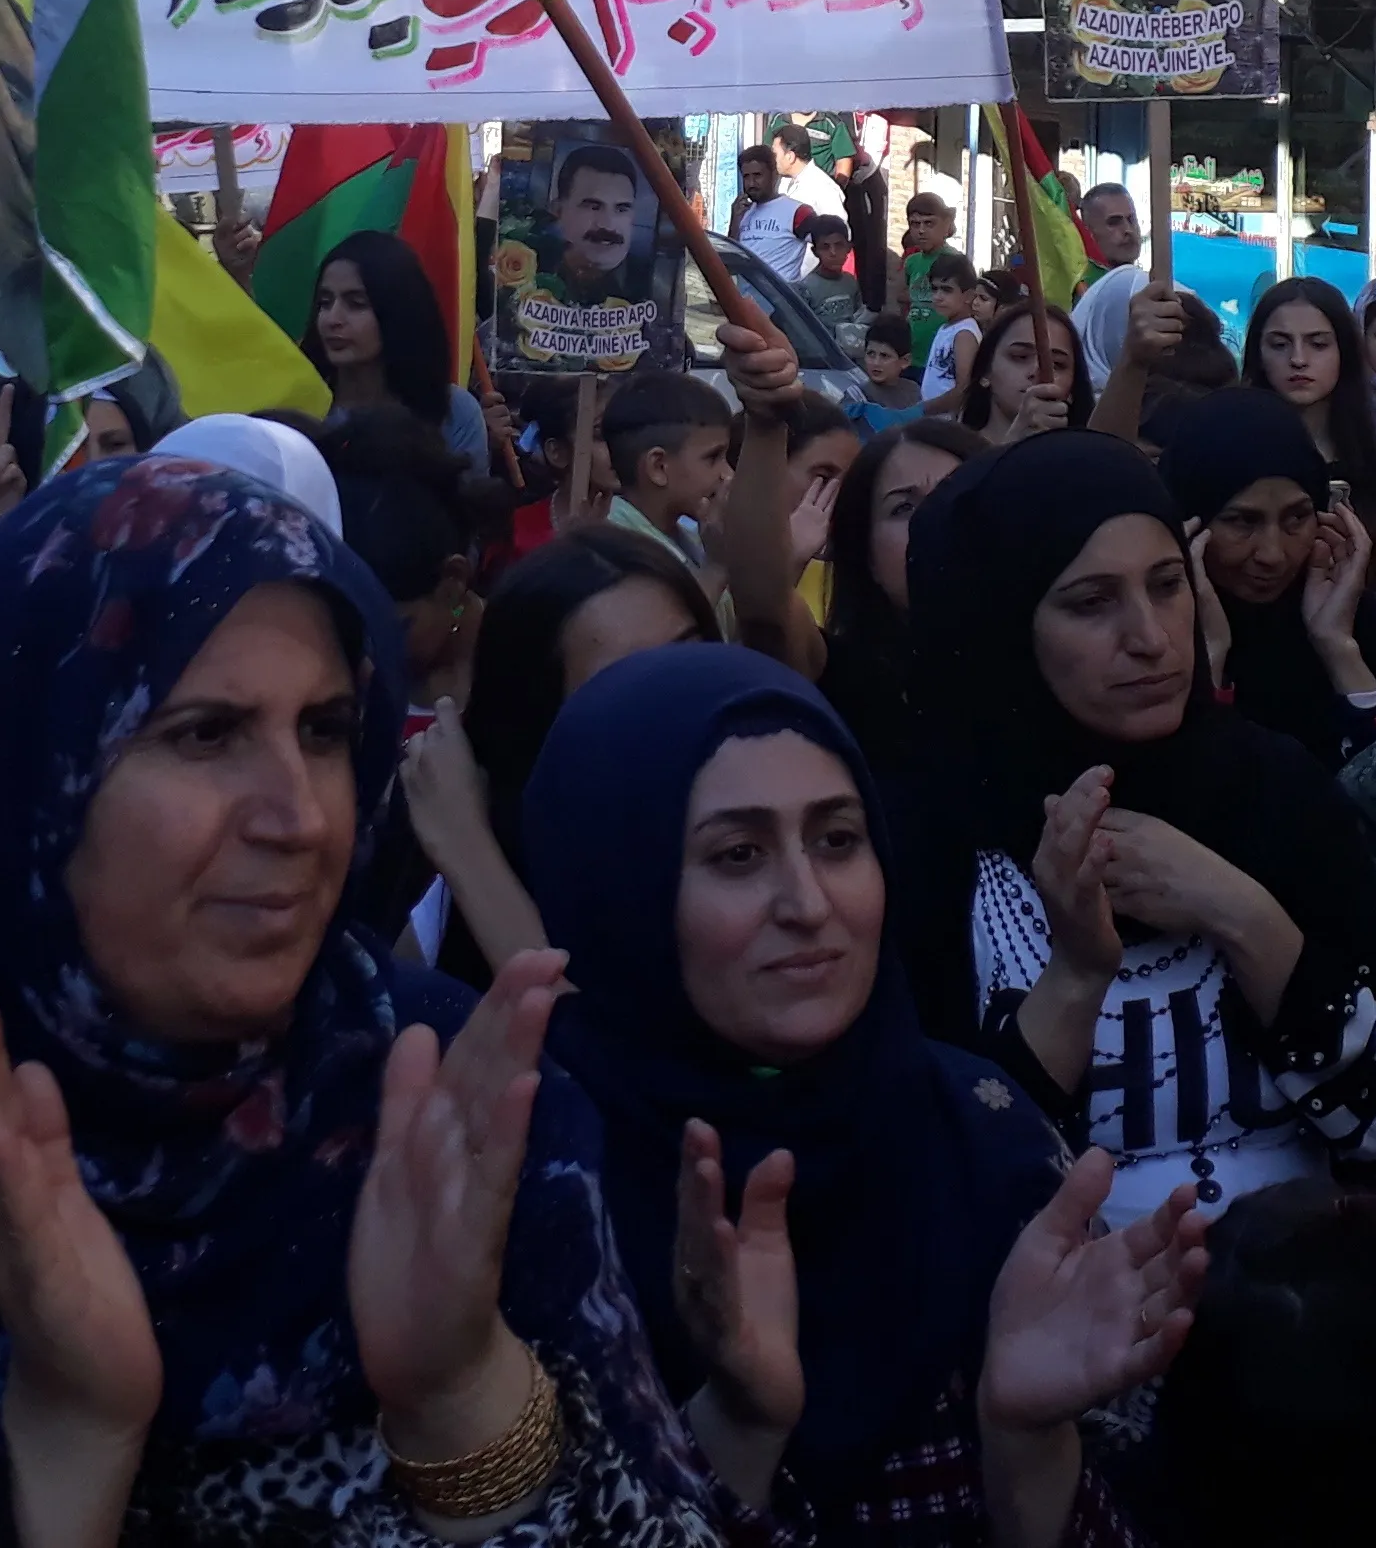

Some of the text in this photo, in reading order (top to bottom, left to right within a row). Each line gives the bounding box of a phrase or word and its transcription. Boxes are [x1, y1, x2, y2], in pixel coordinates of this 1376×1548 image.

[1078, 6, 1146, 39] AZADIYA
[1208, 3, 1241, 32] APO
[1089, 43, 1158, 73] AZADIYA
[524, 301, 579, 327] AZADIYA
[628, 302, 655, 325] APO
[530, 330, 588, 353] AZADIYA
